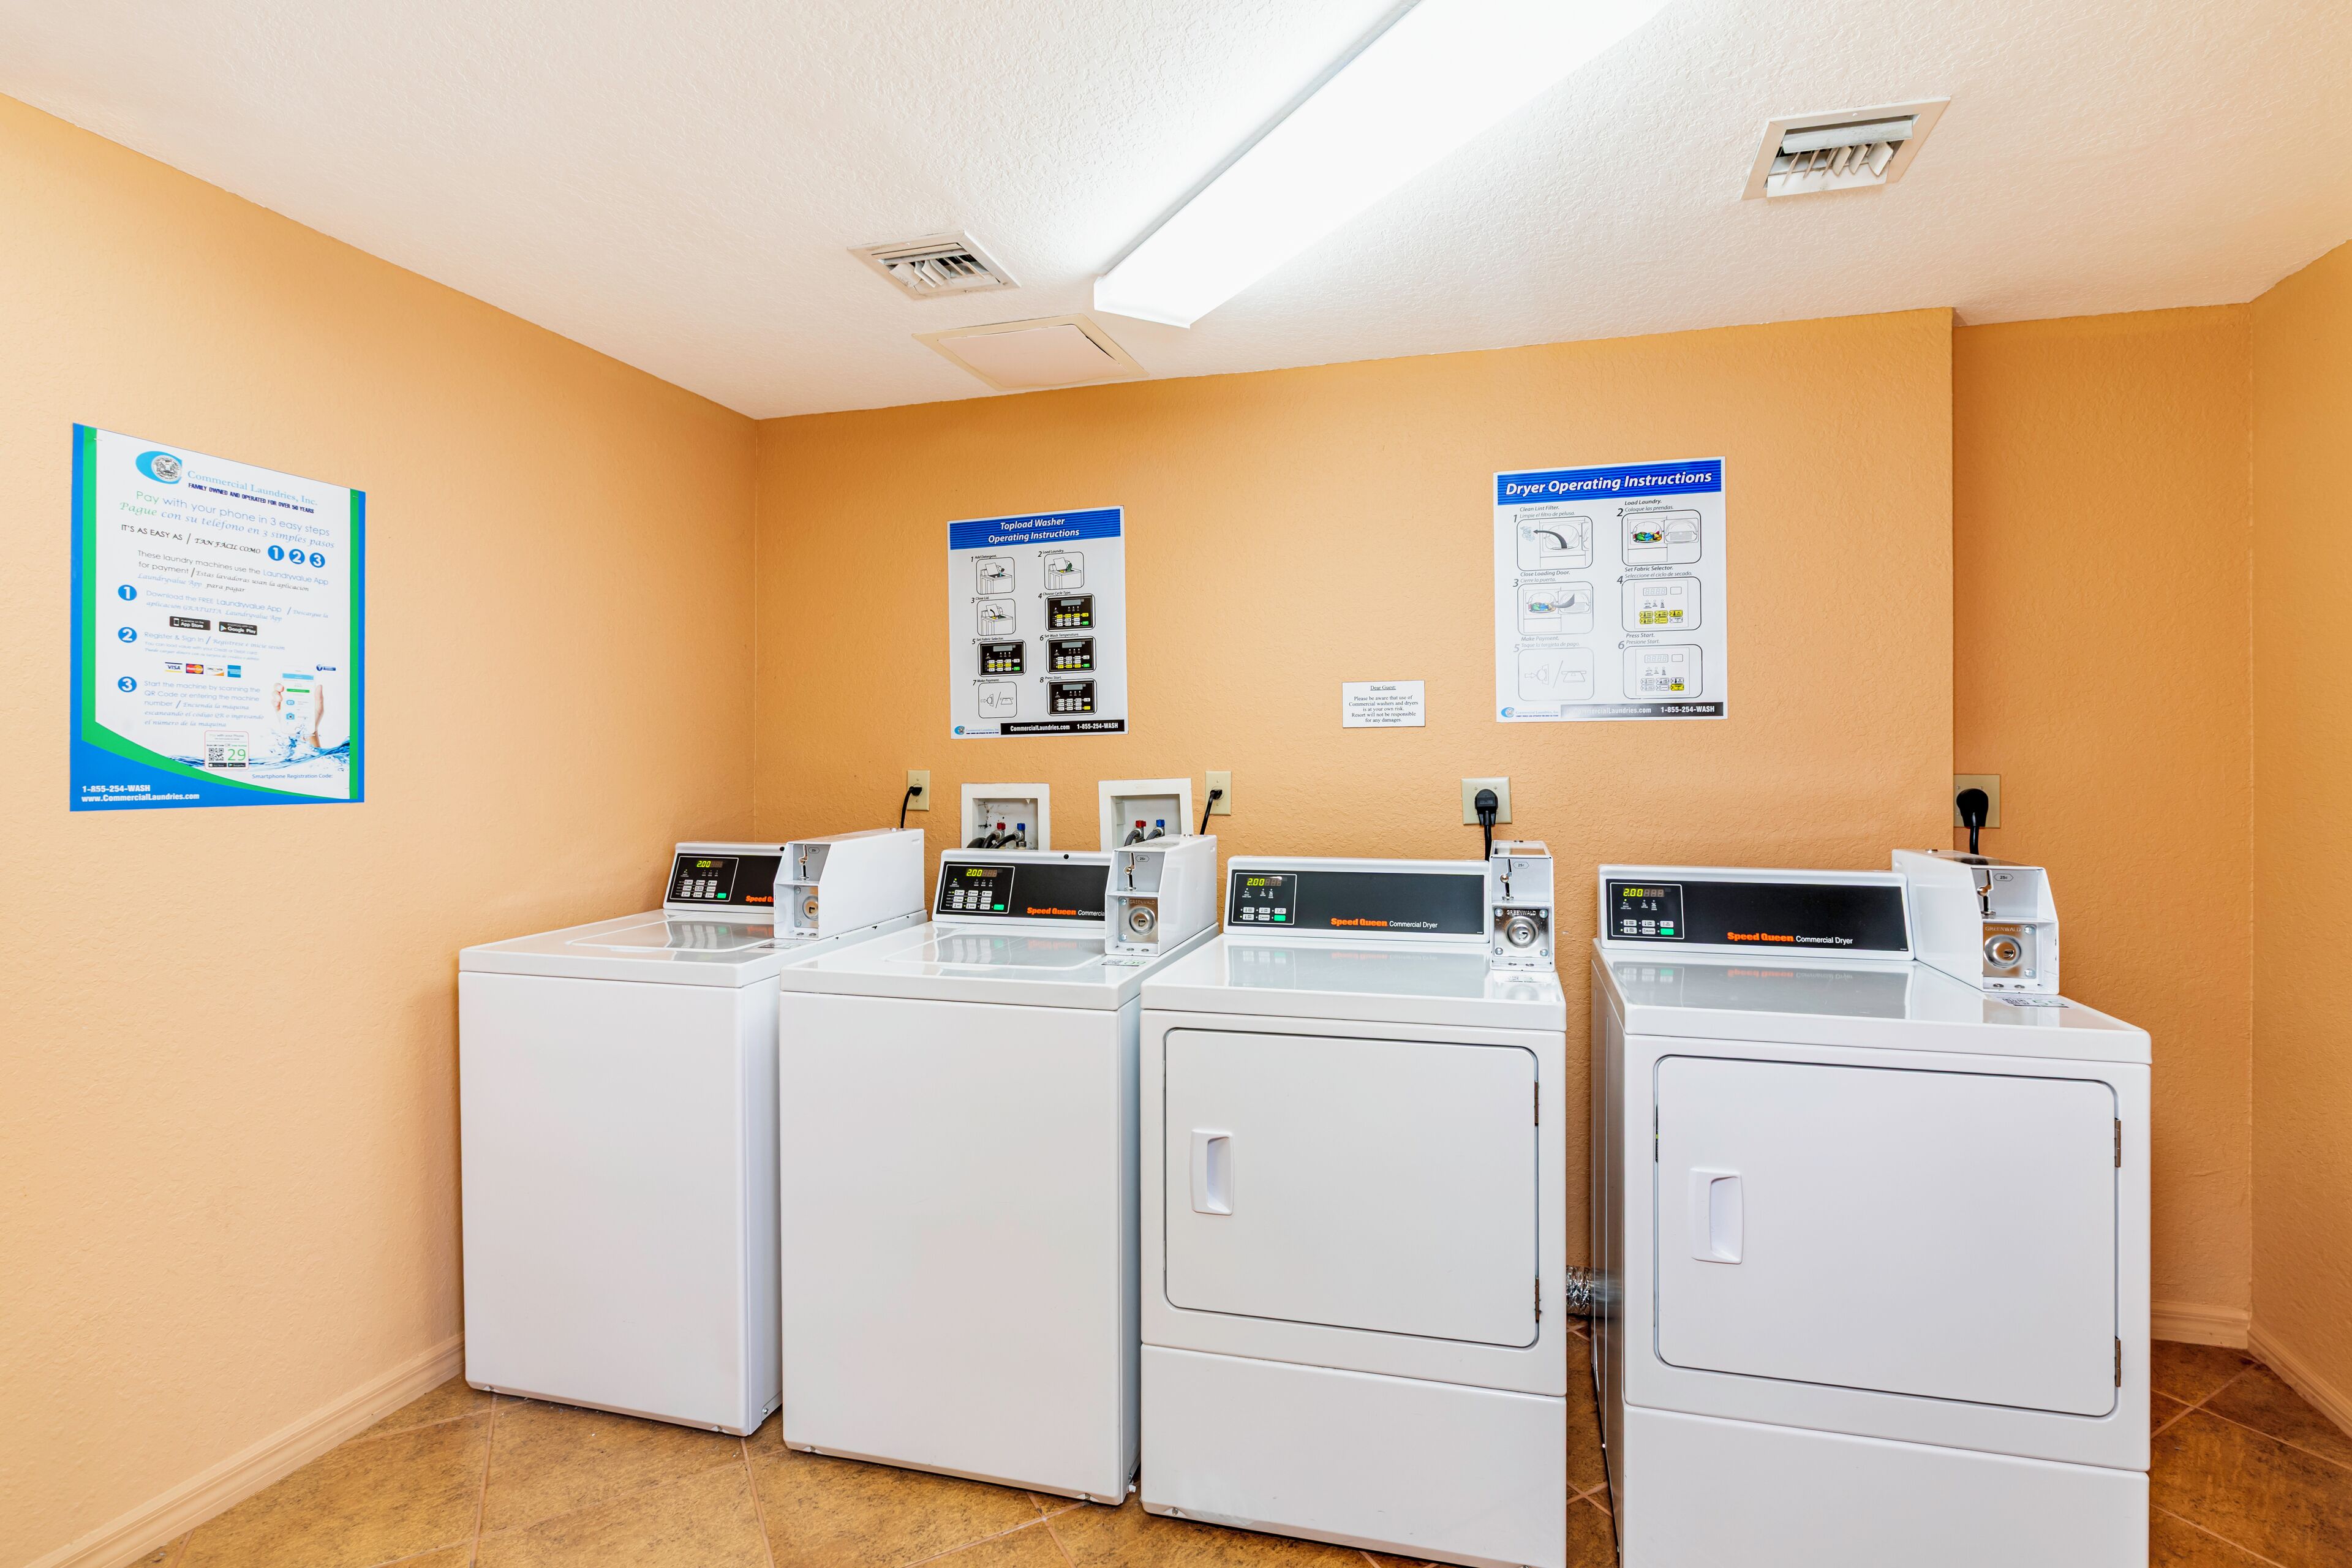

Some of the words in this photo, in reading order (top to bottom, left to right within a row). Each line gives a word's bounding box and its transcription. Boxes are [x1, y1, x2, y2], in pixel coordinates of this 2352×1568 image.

[187, 470, 247, 491] Commercial
[251, 484, 298, 502] Laundries,
[301, 495, 318, 506] Inc.
[1506, 483, 1546, 497] Dryer
[1548, 477, 1621, 494] Operating
[1624, 471, 1713, 488] Instructions
[189, 483, 207, 491] FAMILY
[209, 487, 228, 496] OWNED
[242, 494, 266, 503] OPERATED
[136, 491, 159, 505] Pay
[162, 497, 187, 508] with
[191, 503, 216, 513] your
[220, 508, 255, 522] phone
[258, 514, 267, 524] in
[270, 517, 276, 526] 3
[279, 521, 302, 532] easy
[305, 525, 330, 537] steps
[1513, 514, 1517, 523] 1
[1616, 508, 1623, 517] 2
[119, 501, 157, 516] Pague
[161, 511, 181, 520] con
[271, 530, 306, 543] simples
[307, 539, 335, 549] pasos
[1000, 520, 1033, 530] Topload
[1034, 518, 1065, 527] Washer
[988, 533, 1029, 543] Operating
[1030, 529, 1080, 540] Instructions
[121, 524, 135, 532] IT'S
[150, 529, 170, 538] EASY
[239, 546, 261, 554] COMO
[272, 547, 279, 559] 1
[292, 551, 301, 563] 2
[313, 554, 322, 567] 3
[1513, 578, 1519, 587] 3
[1616, 576, 1623, 584] 4
[123, 586, 130, 599] 1
[122, 628, 132, 641] 2
[1513, 644, 1520, 653] 5
[1618, 640, 1624, 650] 6
[122, 677, 132, 691] 3
[227, 748, 246, 761] 29
[81, 793, 200, 802] www.CommercialLaundries.com
[1246, 878, 1265, 886] 2.00
[1623, 888, 1643, 897] 2.00
[1027, 907, 1052, 915] Speed
[1052, 907, 1077, 916] Queen
[1330, 918, 1359, 927] Speed
[1359, 918, 1388, 927] Queen
[1727, 932, 1760, 941] Speed
[1761, 933, 1794, 942] Queen
[1835, 937, 1853, 945] Dryer
